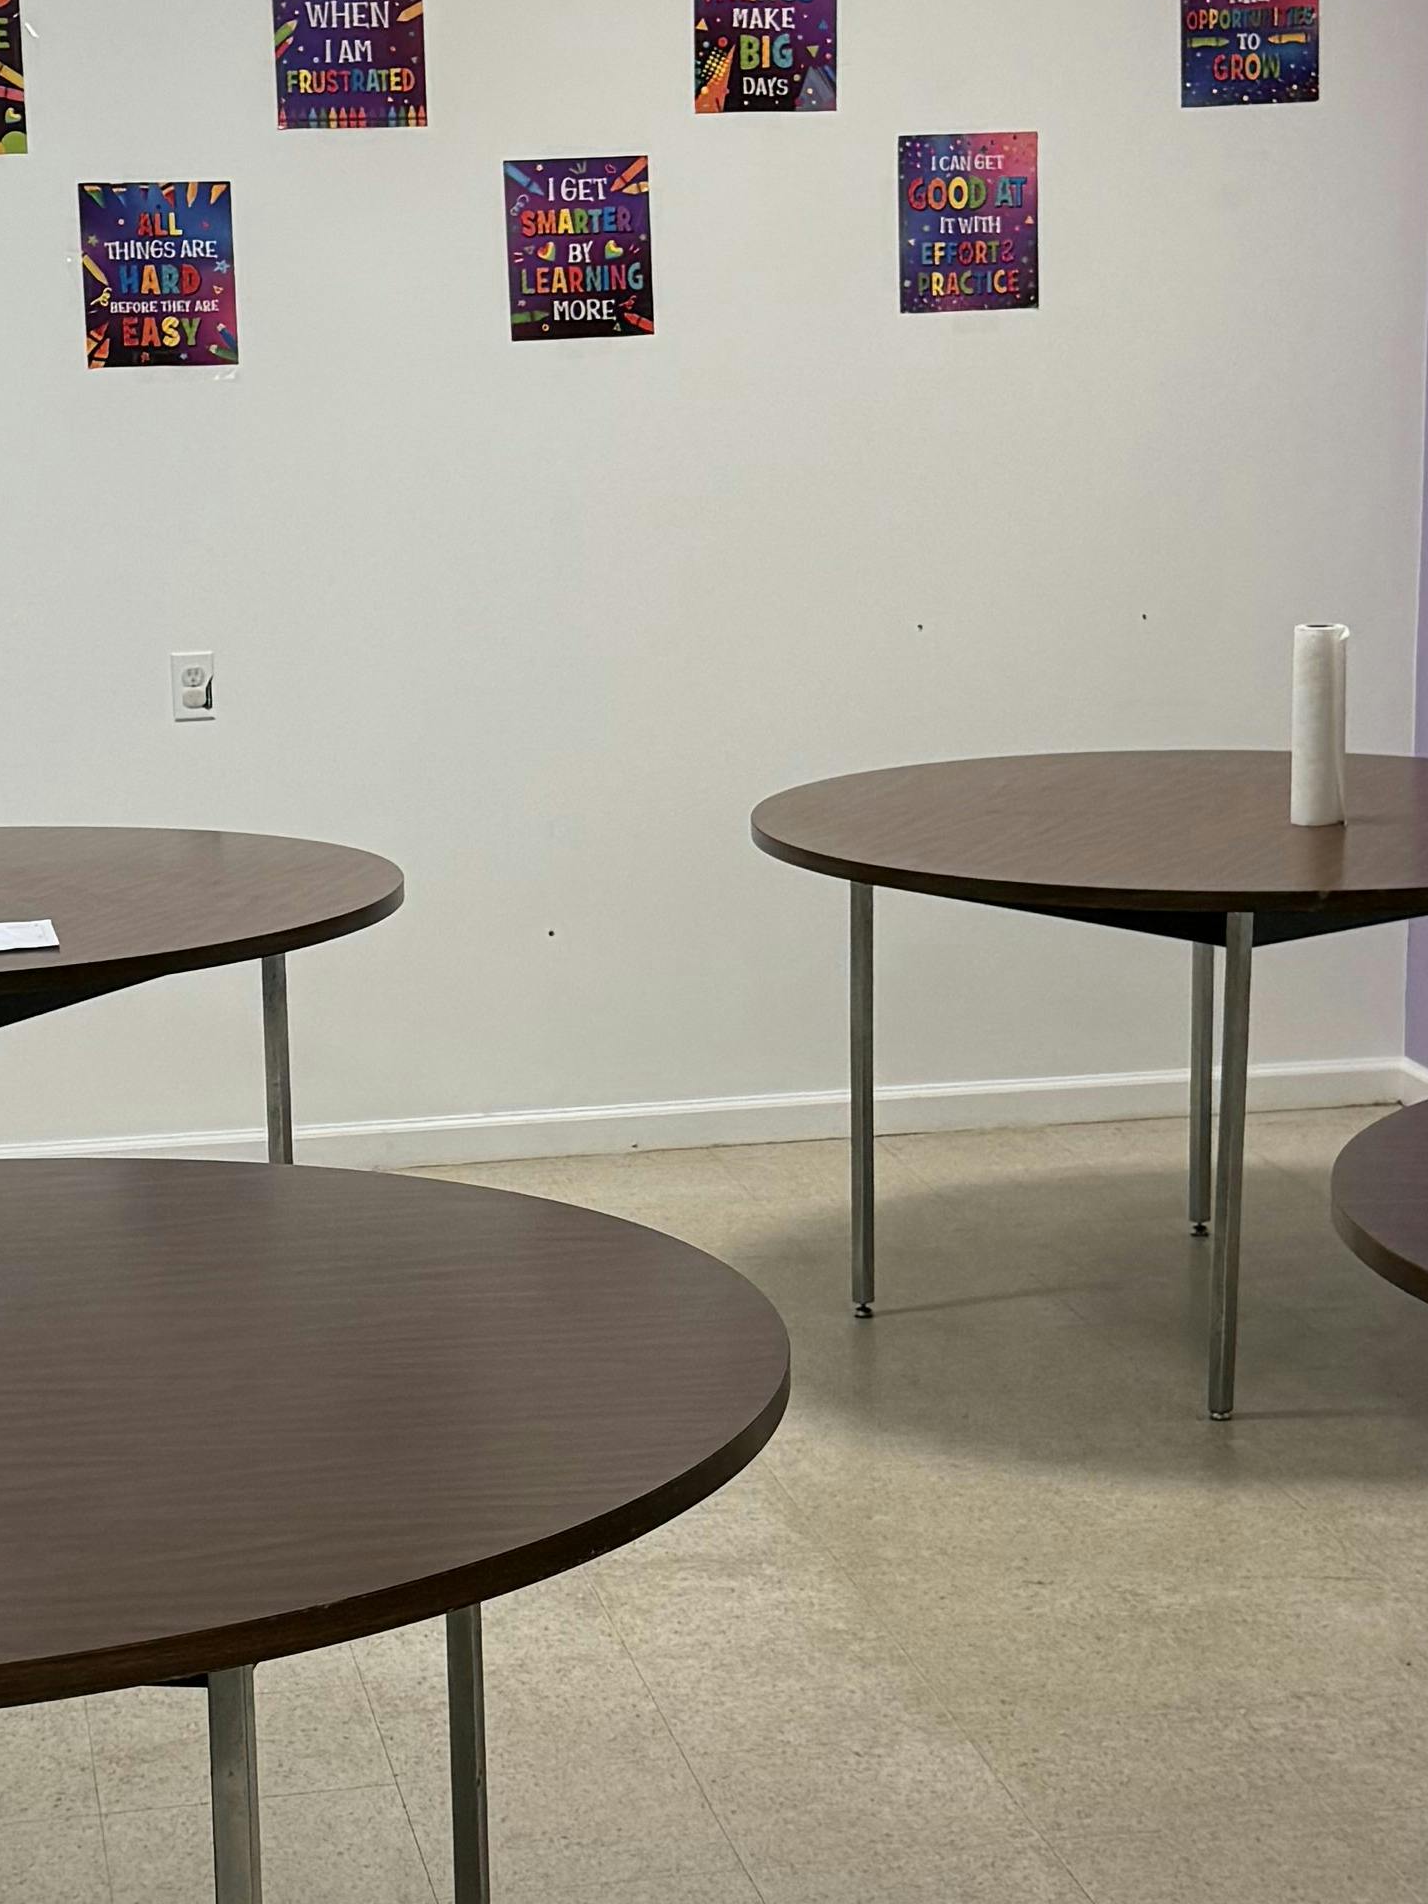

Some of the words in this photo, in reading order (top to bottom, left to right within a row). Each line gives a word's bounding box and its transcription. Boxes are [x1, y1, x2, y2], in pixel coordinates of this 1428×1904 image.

[305, 0, 390, 29] WHEN
[733, 7, 795, 31] MAKE
[325, 39, 331, 63] I
[339, 39, 372, 63] AM
[740, 33, 793, 70] BIG
[1237, 33, 1260, 50] TO
[1213, 53, 1281, 81] GROW
[287, 68, 415, 94] FRUSTRATED
[743, 77, 789, 96] DAYS
[931, 156, 936, 171] I
[939, 156, 971, 171] CAN
[974, 154, 1005, 170] GET
[548, 177, 554, 201] I
[561, 177, 607, 202] GET
[908, 176, 986, 211] GOOD
[995, 176, 1027, 207] AT
[138, 212, 183, 236] ALL
[521, 206, 632, 237] SMARTER
[940, 217, 953, 234] IT
[958, 216, 1001, 234] WITH
[104, 240, 175, 260] THINGS
[181, 240, 218, 258] ARE
[568, 241, 593, 263] BY
[922, 241, 1000, 265] EFFORT
[120, 264, 200, 295] HARD
[521, 262, 644, 294] LEARNING
[918, 269, 1020, 296] PRACTICE
[110, 301, 158, 313] BEFORE
[160, 300, 191, 312] THEY
[195, 300, 219, 312] ARE
[553, 299, 616, 321] MORE
[123, 317, 201, 346] EASY
